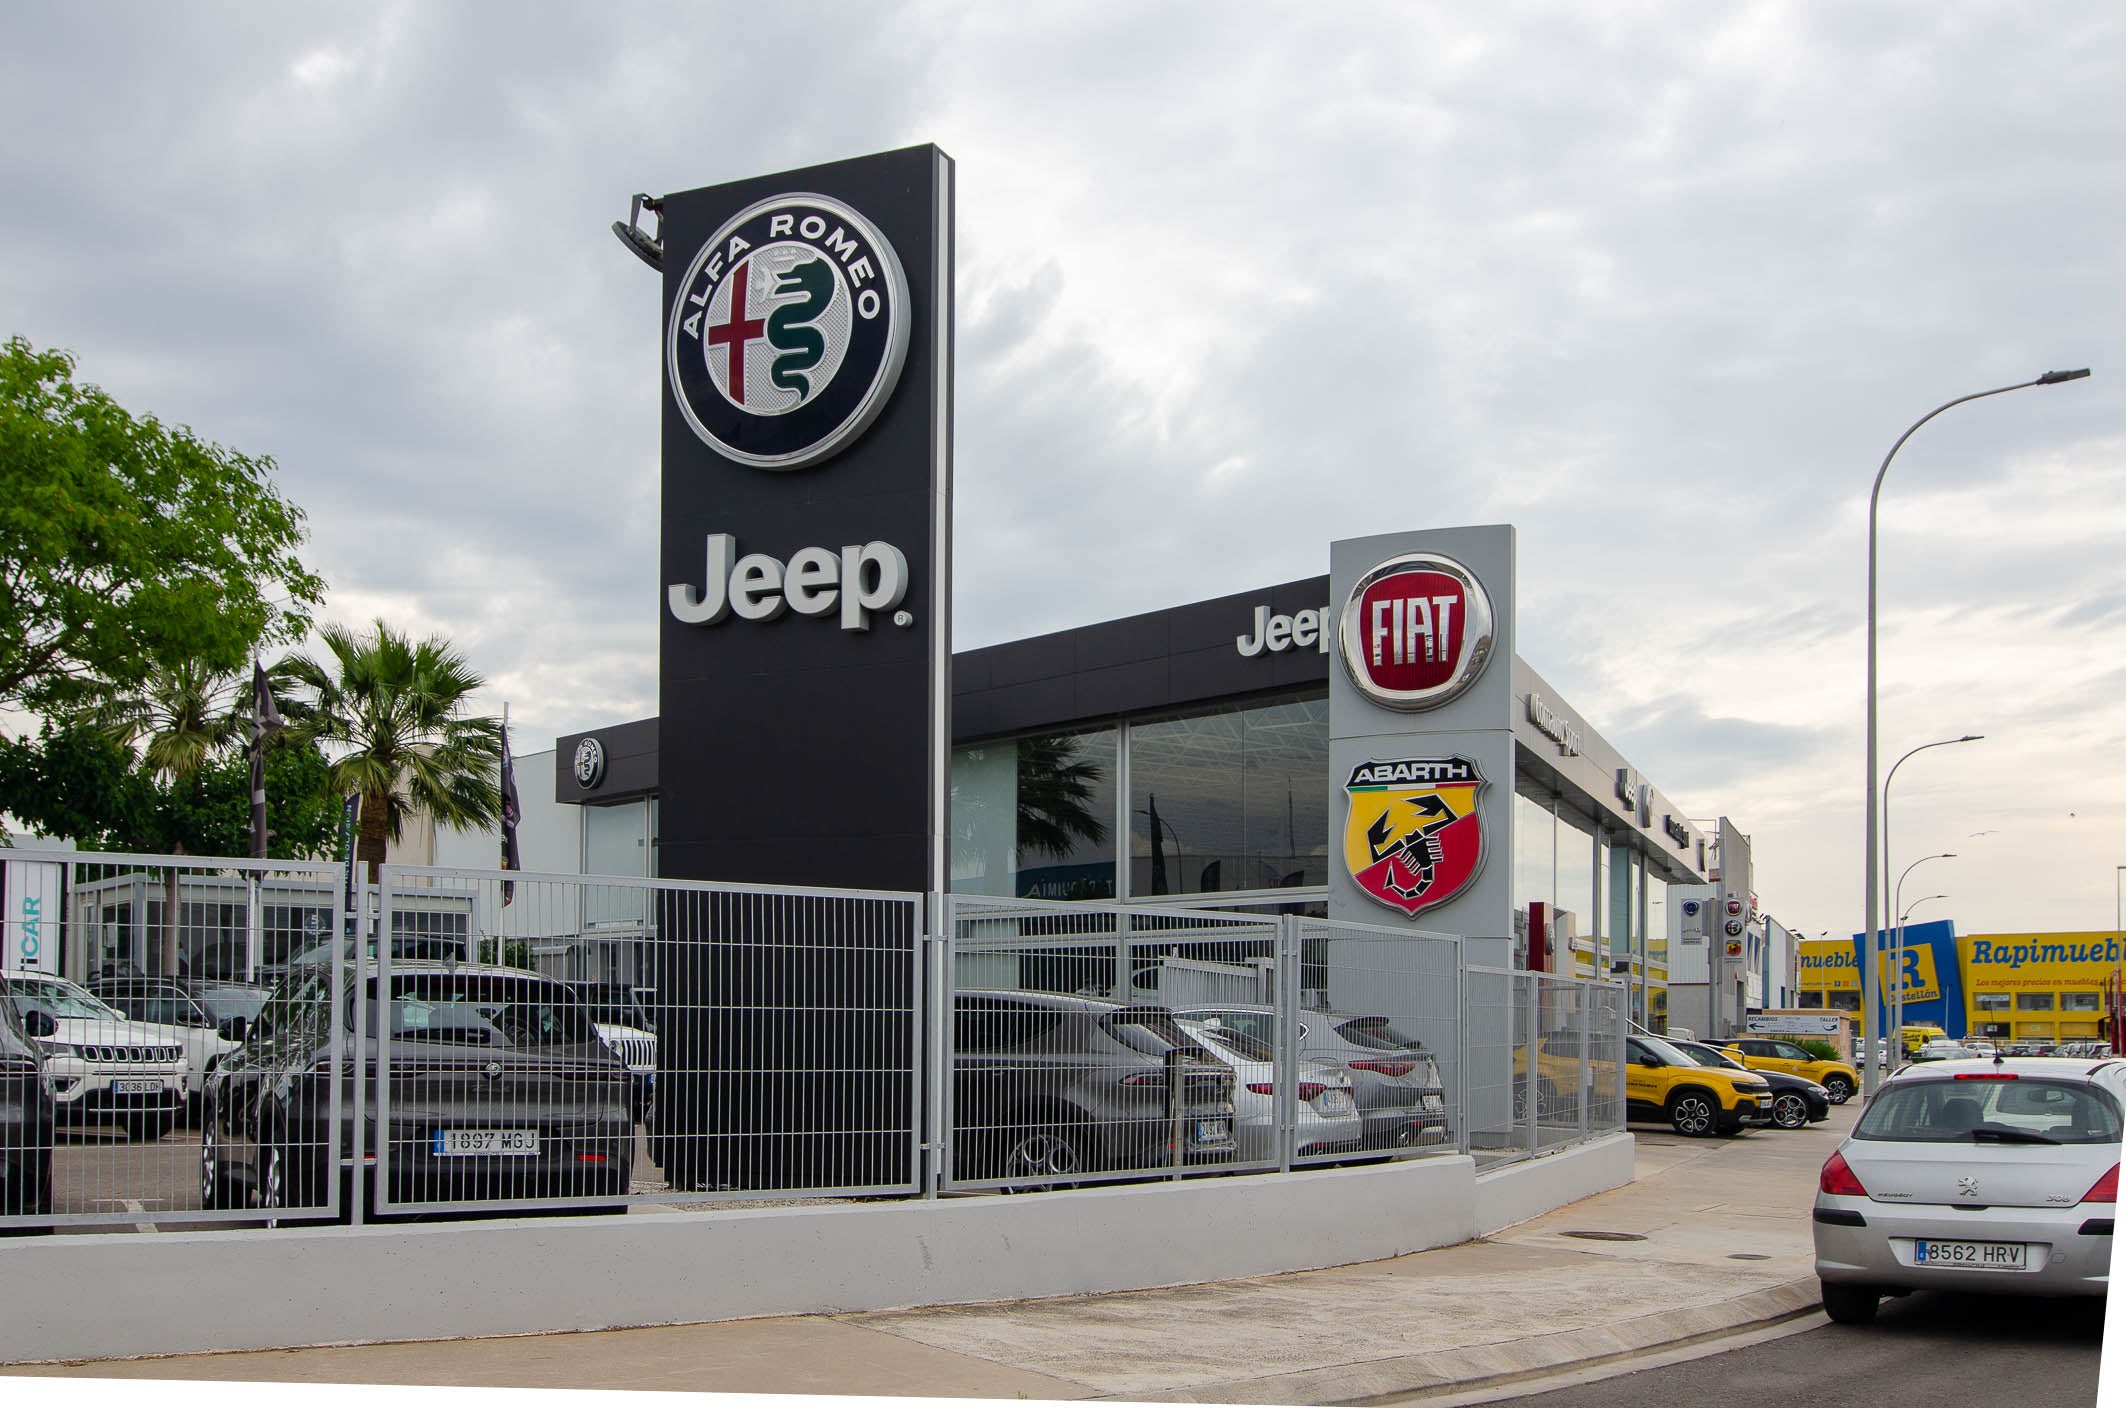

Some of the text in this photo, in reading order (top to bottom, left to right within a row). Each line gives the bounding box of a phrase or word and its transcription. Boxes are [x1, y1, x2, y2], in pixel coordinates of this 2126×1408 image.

[683, 214, 881, 341] ALFA ROMEO
[668, 532, 909, 631] Jeep
[1371, 594, 1458, 667] FIAT
[1353, 761, 1468, 783] ABARTH
[1890, 949, 1926, 991] R
[1929, 1245, 2020, 1263] 8562 HRV
